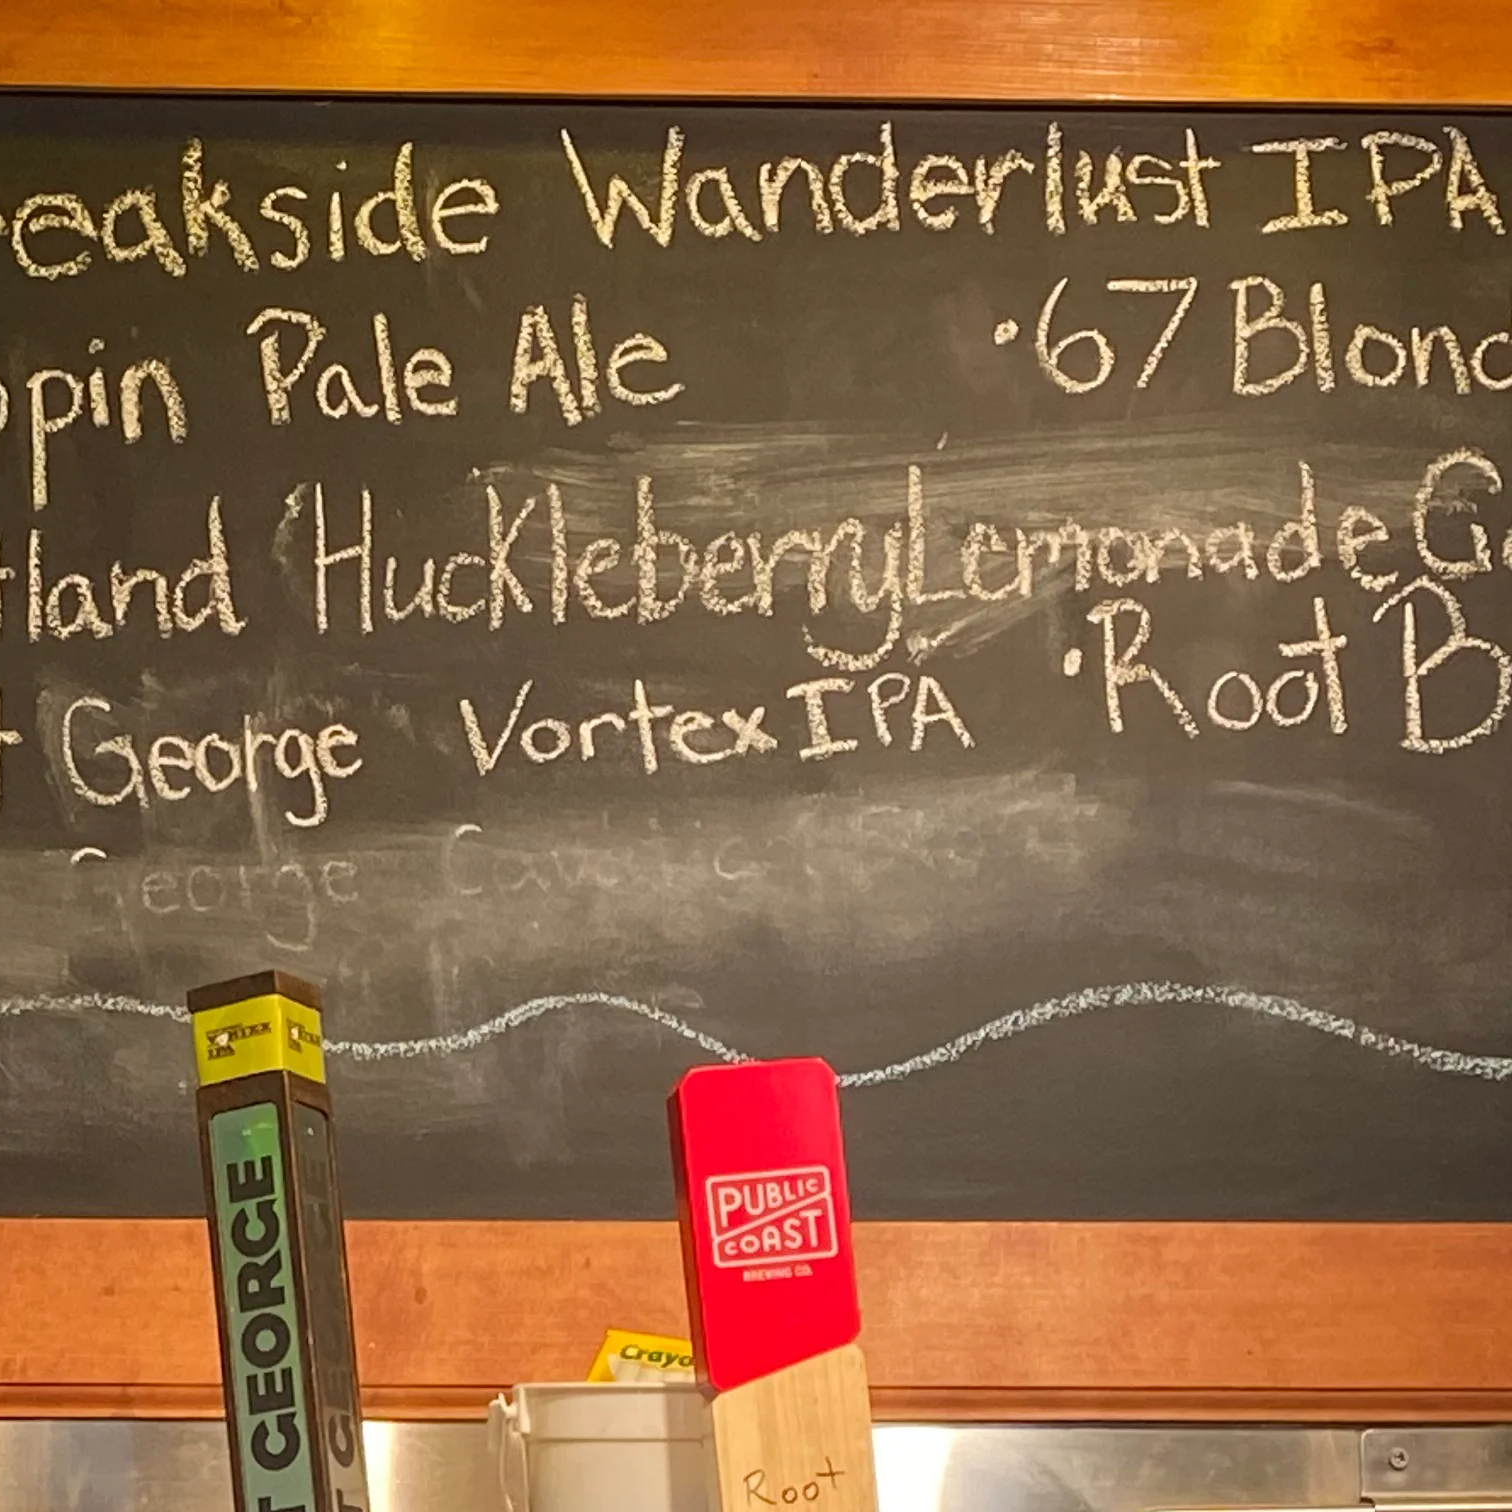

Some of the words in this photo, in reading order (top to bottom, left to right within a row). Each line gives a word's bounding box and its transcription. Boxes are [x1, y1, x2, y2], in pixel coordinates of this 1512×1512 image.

[559, 119, 1222, 250] Wanderlust
[1246, 124, 1507, 238] IPA
[247, 307, 457, 425] Pale
[508, 293, 685, 426] Ale
[1033, 276, 1198, 394] 67
[315, 475, 902, 671] Huckleberry
[1088, 597, 1347, 740] Root
[63, 696, 362, 827] George
[460, 679, 778, 776] Vortex
[787, 673, 976, 761] IPA
[717, 1178, 820, 1228] PUBLIC
[724, 1209, 822, 1256] COAST
[226, 1154, 301, 1472] GEORGE
[743, 1266, 792, 1282] BREWING
[743, 1456, 845, 1507] Root
